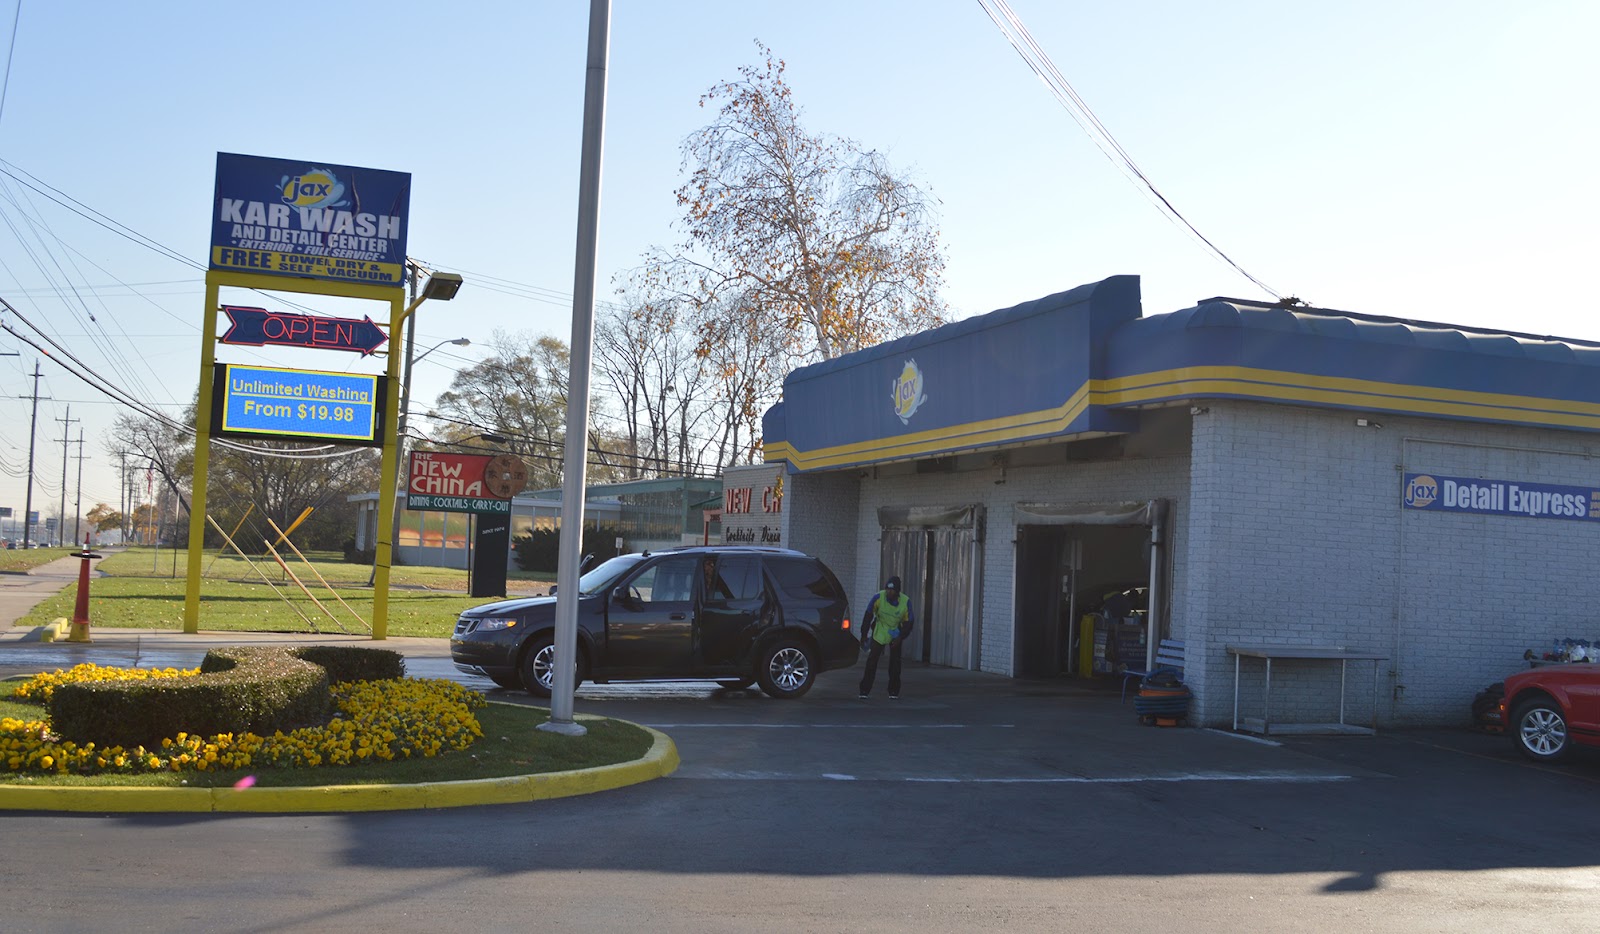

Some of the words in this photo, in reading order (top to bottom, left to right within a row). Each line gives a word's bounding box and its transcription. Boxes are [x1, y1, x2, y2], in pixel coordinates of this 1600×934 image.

[281, 176, 330, 204] jax
[221, 198, 290, 228] KAR
[300, 206, 400, 239] WASH
[231, 224, 267, 241] AND
[270, 228, 323, 246] DETAIL
[328, 233, 388, 253] CENTER
[238, 239, 294, 254] EXTERIOR
[304, 246, 331, 257] FULL
[331, 249, 380, 262] SERVICE
[220, 249, 272, 269] FREE
[279, 254, 331, 267] TOWEL
[335, 260, 366, 271] DRY
[369, 263, 381, 272] &
[279, 263, 313, 274] SELF
[327, 267, 393, 281] VACUUM
[263, 316, 353, 345] OPEN
[232, 379, 302, 396] Unlimited
[307, 384, 369, 402] Washing
[894, 377, 916, 415] jax
[244, 401, 291, 418] From
[297, 404, 354, 421] $19.98
[413, 460, 462, 478] NEW
[411, 477, 482, 496] CHINA
[1405, 480, 1437, 506] jax
[1443, 480, 1504, 511] Detail
[1509, 485, 1586, 517] Express
[409, 497, 430, 507] DINING
[433, 498, 468, 509] COCKTAILS
[472, 500, 509, 511] CARRY-OUT
[725, 488, 752, 514] NEW
